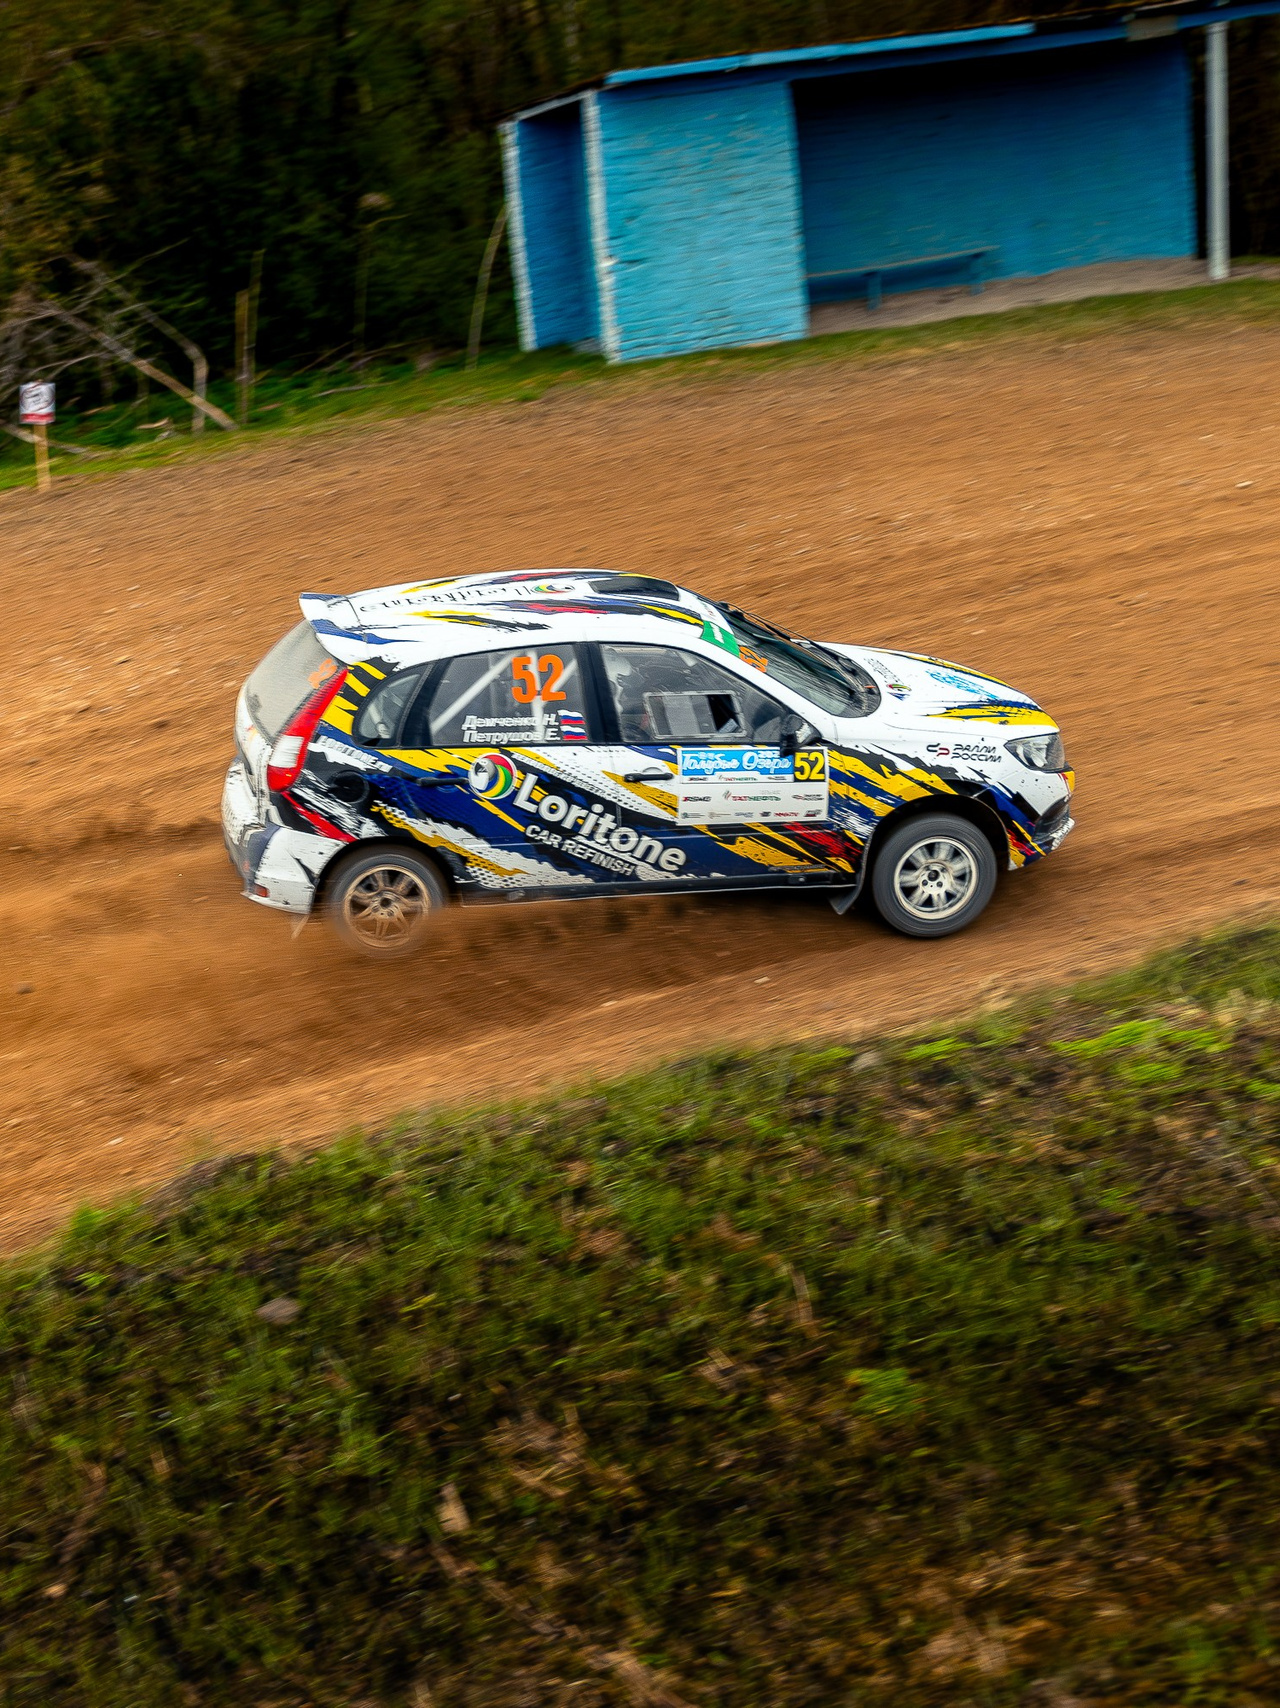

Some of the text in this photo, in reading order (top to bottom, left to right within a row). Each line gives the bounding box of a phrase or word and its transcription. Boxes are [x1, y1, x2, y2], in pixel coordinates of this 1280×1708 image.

[510, 653, 567, 704] 52
[543, 713, 560, 726] Н.
[545, 727, 561, 741] Е.
[951, 752, 1003, 764] РОССИИ
[953, 743, 997, 754] РАЛЛИ
[794, 751, 826, 781] 52
[512, 772, 687, 872] Loritone
[525, 825, 636, 877] CAR REFINISH
